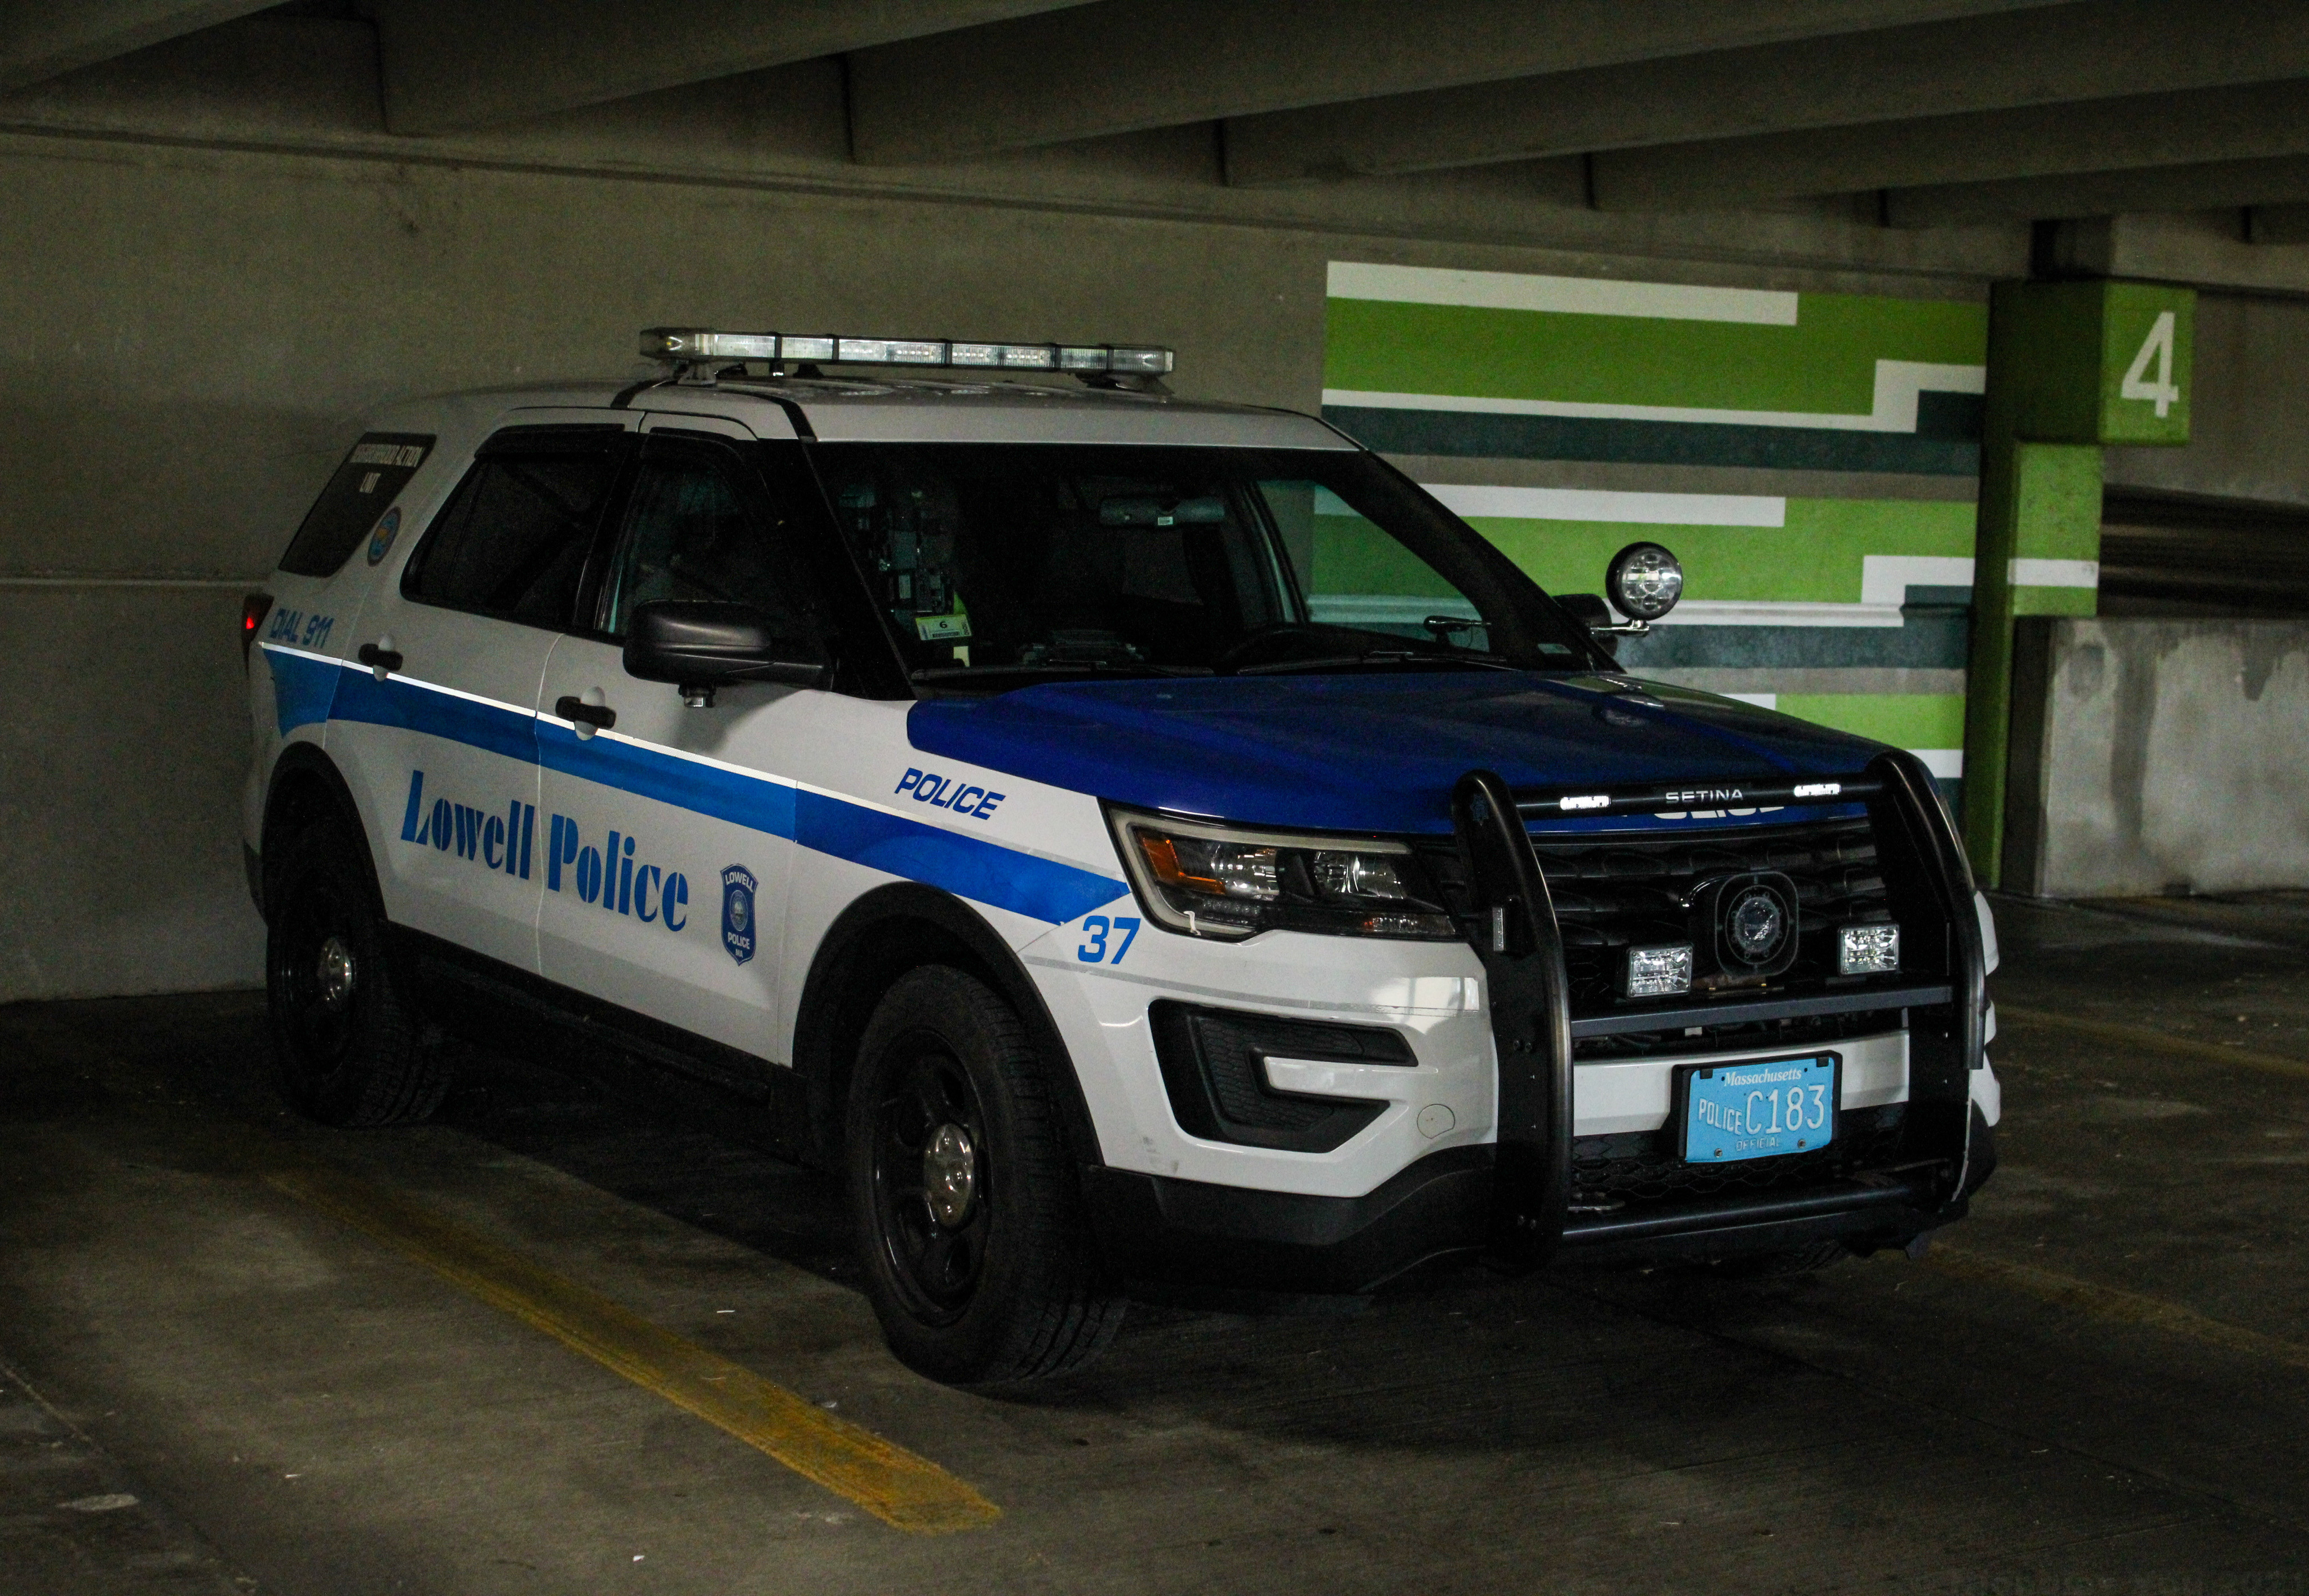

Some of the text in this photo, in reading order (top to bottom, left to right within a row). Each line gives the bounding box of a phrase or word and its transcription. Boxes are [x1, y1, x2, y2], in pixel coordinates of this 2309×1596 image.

[2120, 311, 2179, 418] 4
[269, 608, 334, 648] DIAL 911
[894, 767, 1006, 820] POLICE
[1665, 789, 1744, 804] SETINA
[401, 770, 688, 932] Lowell Police
[724, 871, 754, 893] LOWELL
[727, 931, 750, 949] POLICE
[735, 948, 744, 958] MA
[1077, 915, 1142, 965] 37
[1724, 1068, 1802, 1086] Massachusetts
[1698, 1084, 1825, 1136] POLICE C183
[1736, 1137, 1779, 1152] OFFICIAL
